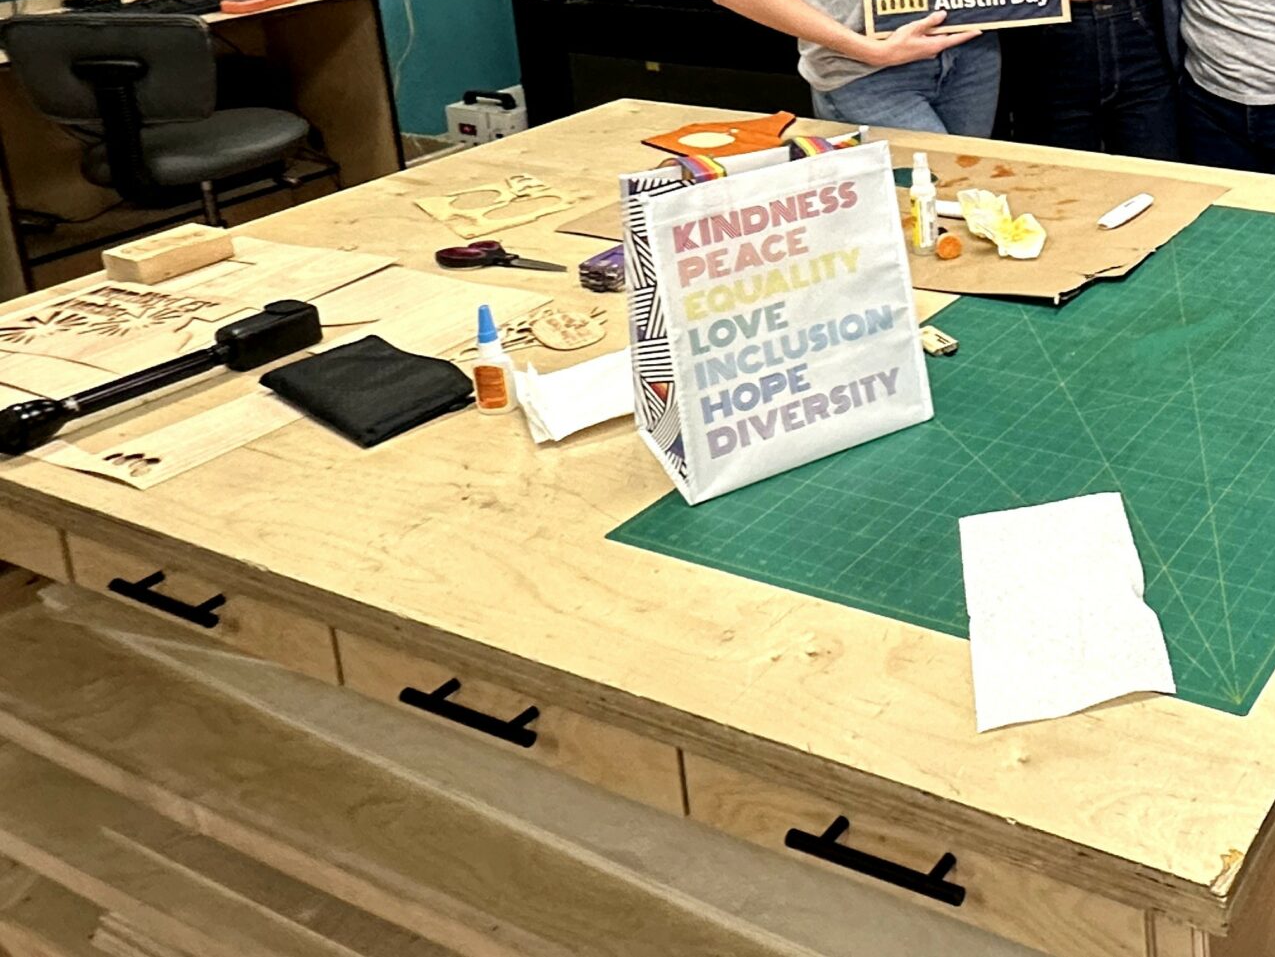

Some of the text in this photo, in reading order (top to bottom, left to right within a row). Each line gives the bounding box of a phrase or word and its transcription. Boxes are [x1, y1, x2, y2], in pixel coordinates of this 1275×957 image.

[672, 182, 858, 254] KINDNESS
[677, 227, 810, 288] PEACE
[682, 248, 861, 321] EQUALITY
[687, 302, 790, 356] LOVE
[694, 304, 894, 390] INCLUSION
[700, 363, 811, 425] HOPE
[706, 367, 900, 460] DIVERSITY
